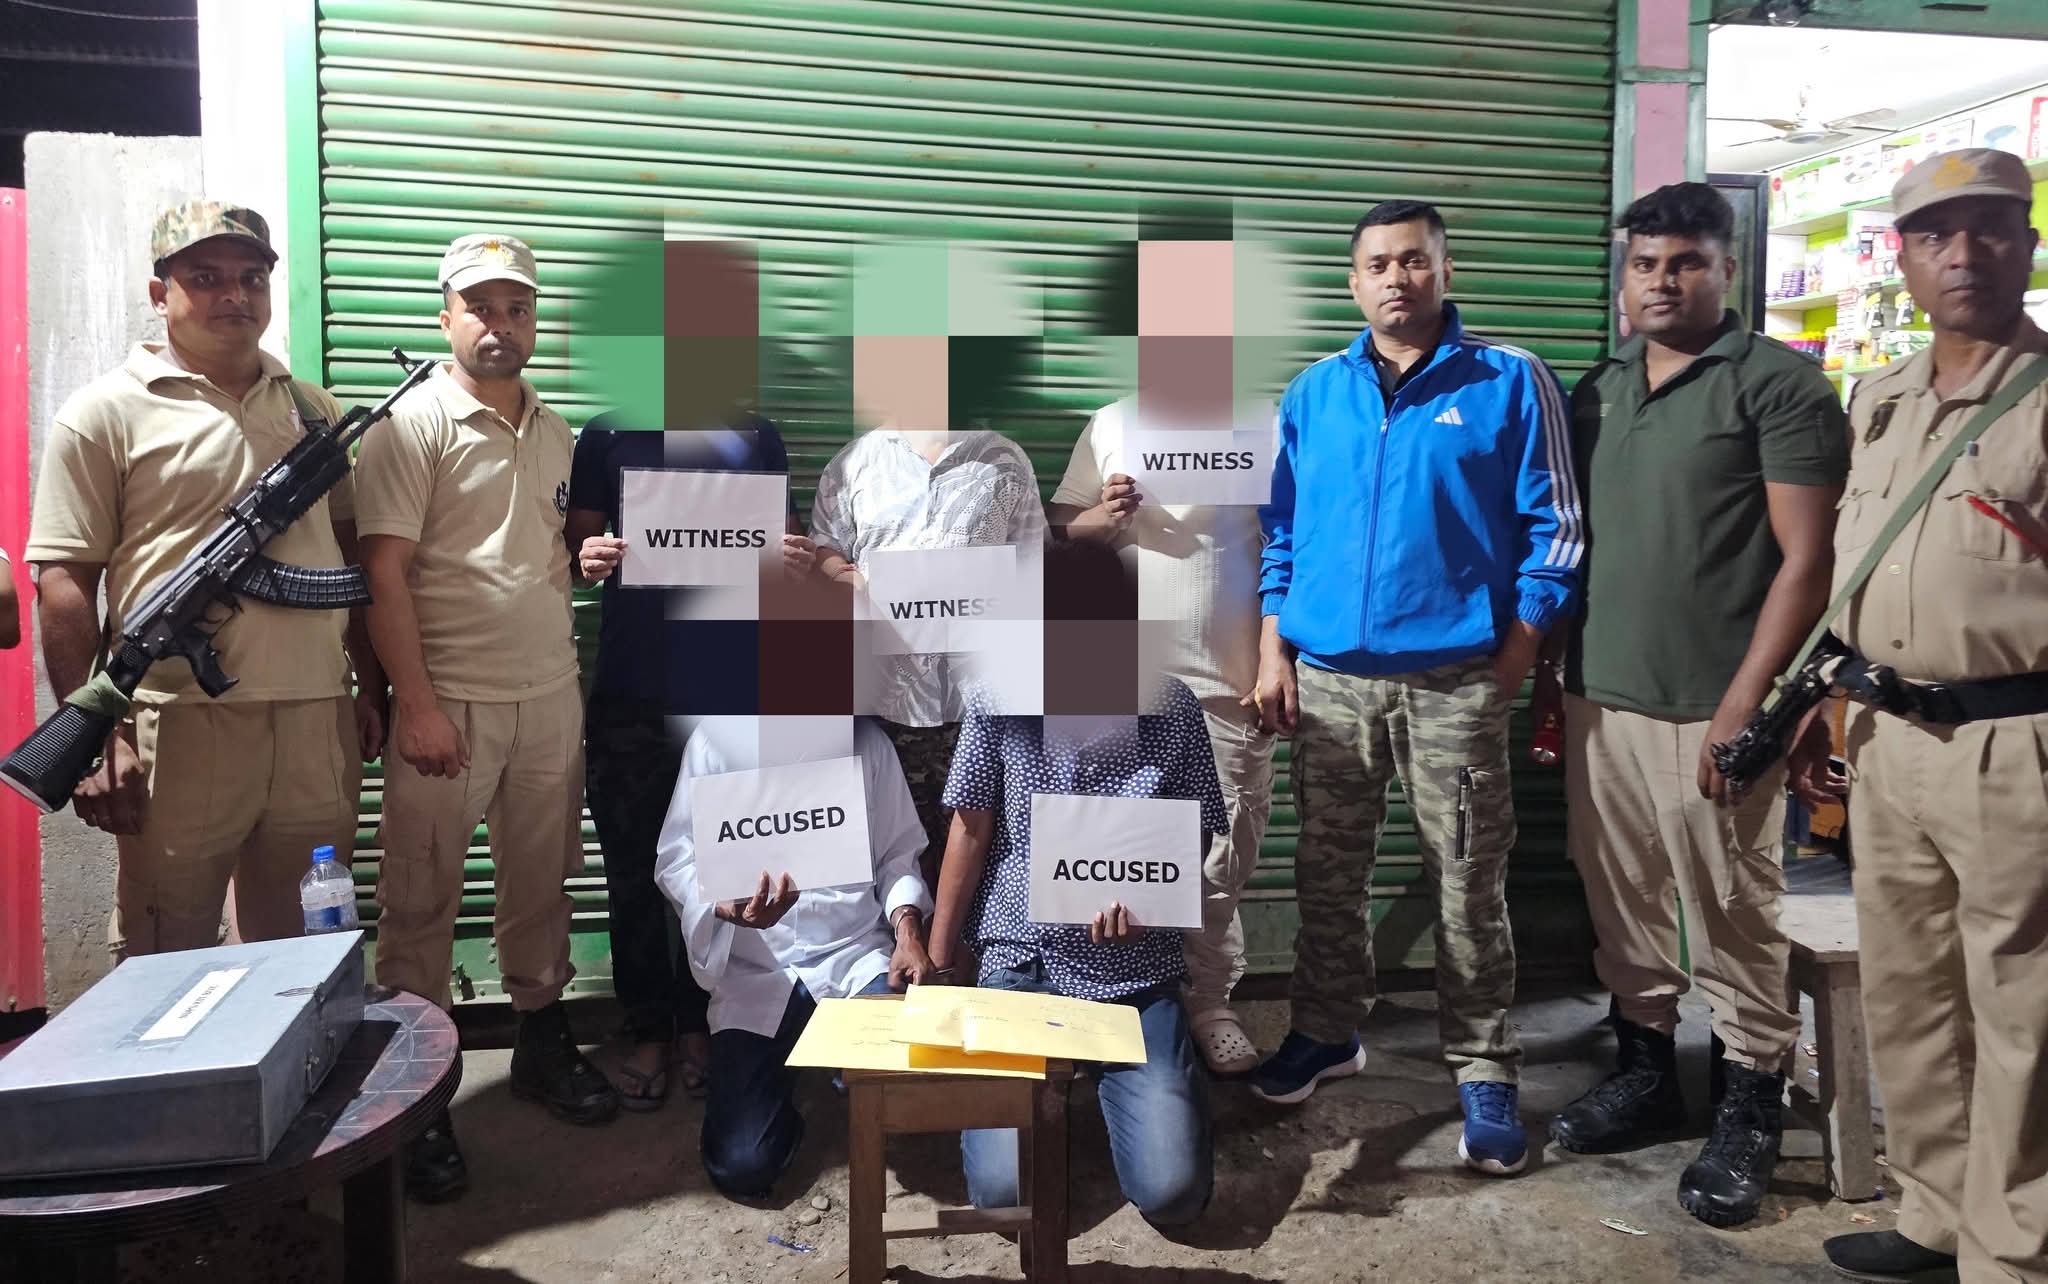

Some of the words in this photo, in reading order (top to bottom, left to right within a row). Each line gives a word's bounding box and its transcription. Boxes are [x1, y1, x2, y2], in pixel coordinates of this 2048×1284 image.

[1142, 451, 1255, 472] WITNESS
[645, 528, 767, 549] WITNESS
[717, 806, 846, 843] ACCUSED
[1052, 859, 1180, 884] ACCUSED
